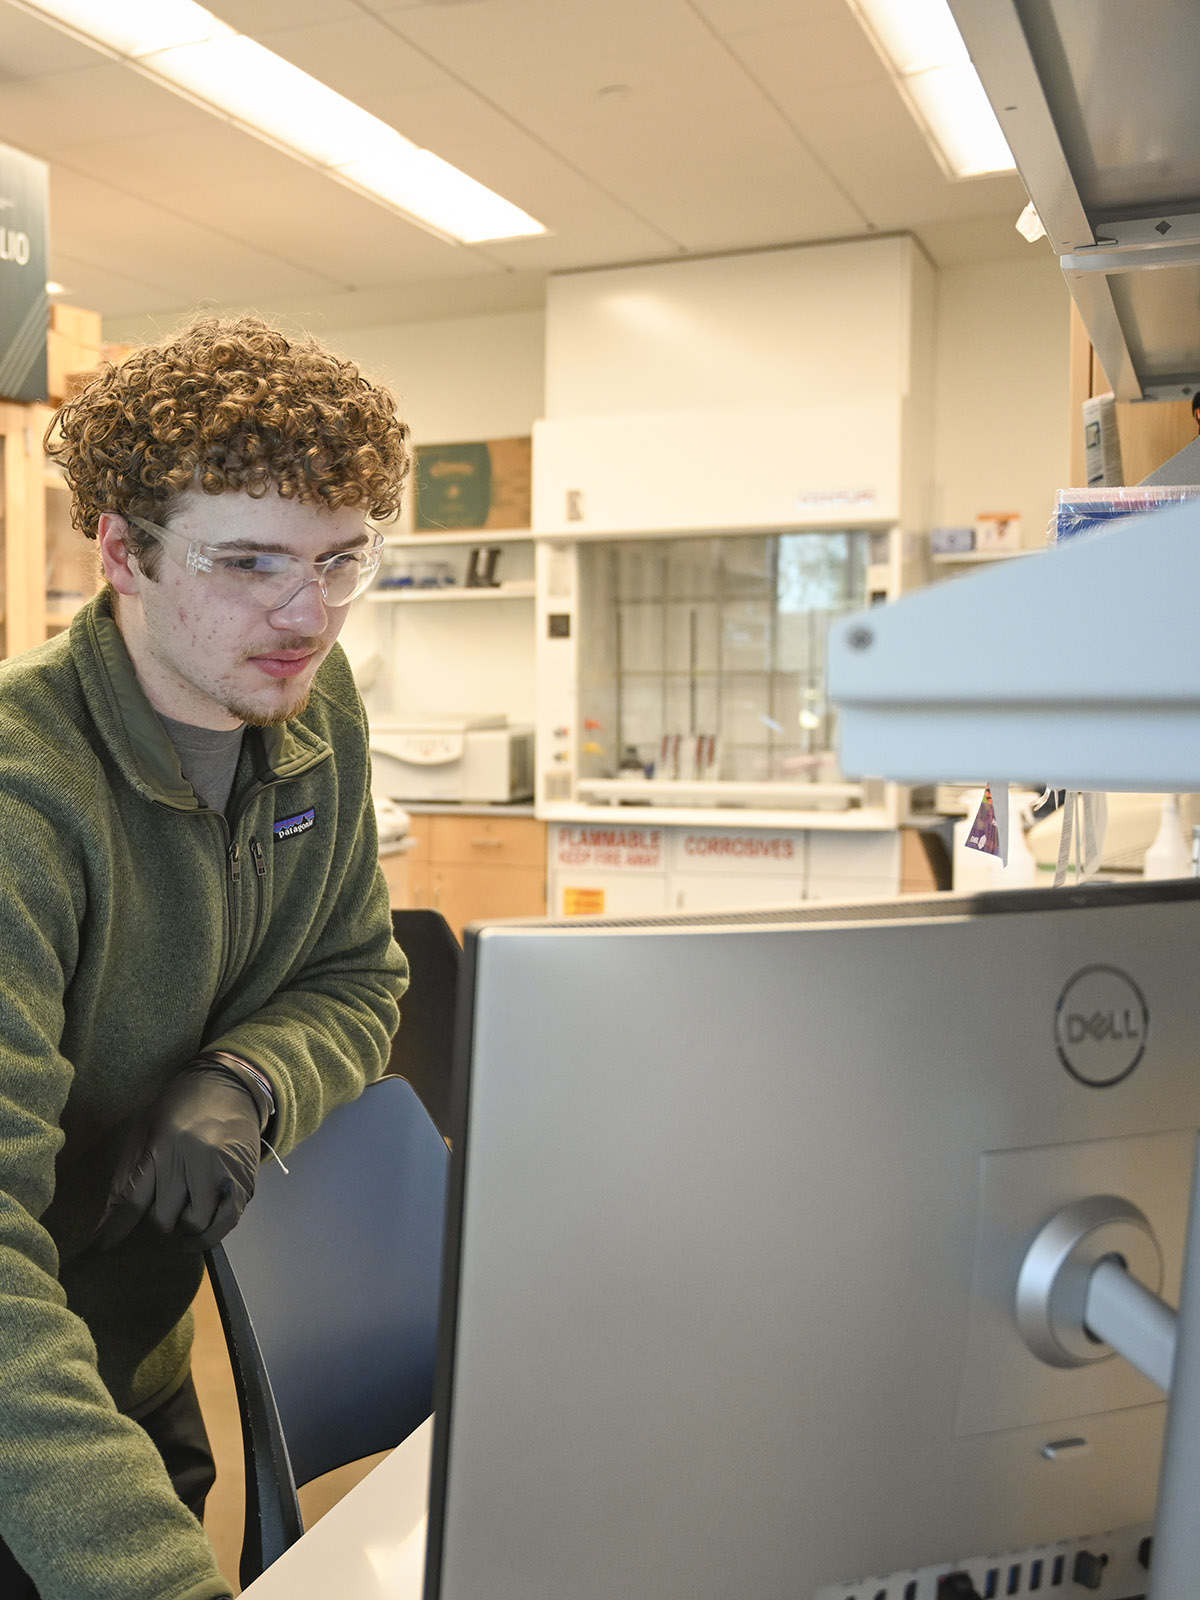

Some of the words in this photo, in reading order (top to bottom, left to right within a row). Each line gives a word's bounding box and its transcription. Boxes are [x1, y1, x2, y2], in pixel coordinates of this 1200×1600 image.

[559, 828, 661, 850] FLAMMABLE
[684, 835, 795, 860] CORROSIVES
[1066, 1010, 1138, 1044] DELL
